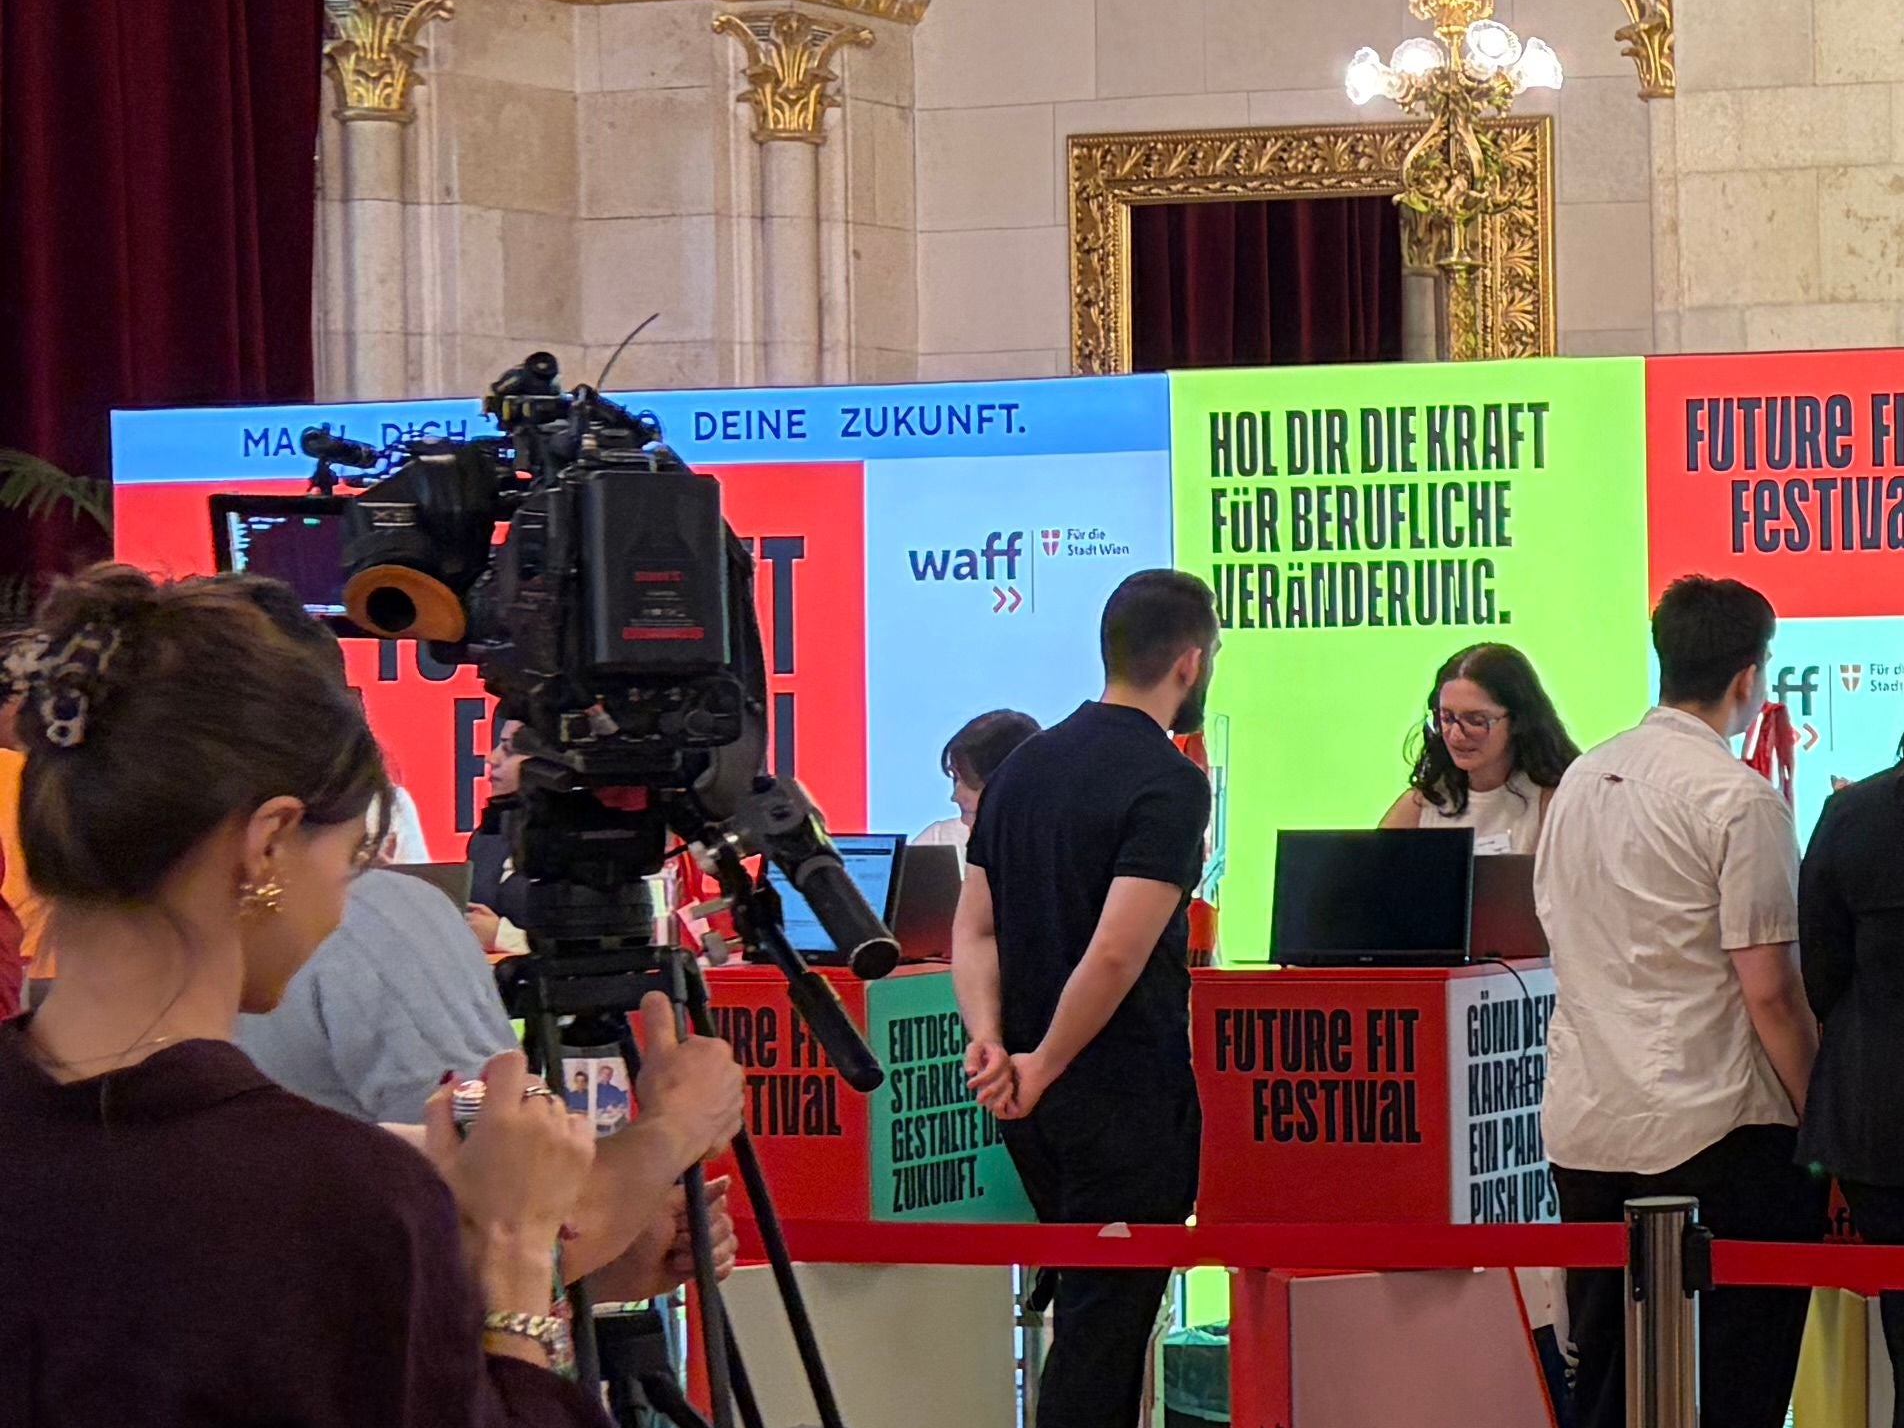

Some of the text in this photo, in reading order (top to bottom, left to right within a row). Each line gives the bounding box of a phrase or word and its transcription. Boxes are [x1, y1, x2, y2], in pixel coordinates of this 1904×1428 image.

[694, 409, 807, 441] DEINE
[840, 403, 1027, 438] ZUKUNFT.
[1209, 401, 1550, 478] HOL DIR DIE KRAFT
[1212, 480, 1513, 554] FÜR BERUFLICHE
[908, 531, 1023, 581] waff
[1214, 558, 1512, 630] VERÄNDERUNG.
[1366, 1008, 1420, 1074] FIT
[1467, 990, 1519, 1058] GÖNN
[1468, 1051, 1547, 1118] KARRIER
[890, 1105, 979, 1164] GESTALTE
[1469, 1119, 1498, 1176] EIN
[892, 1155, 985, 1213] ZUKUNFT.
[1470, 1174, 1519, 1224] PUSH
